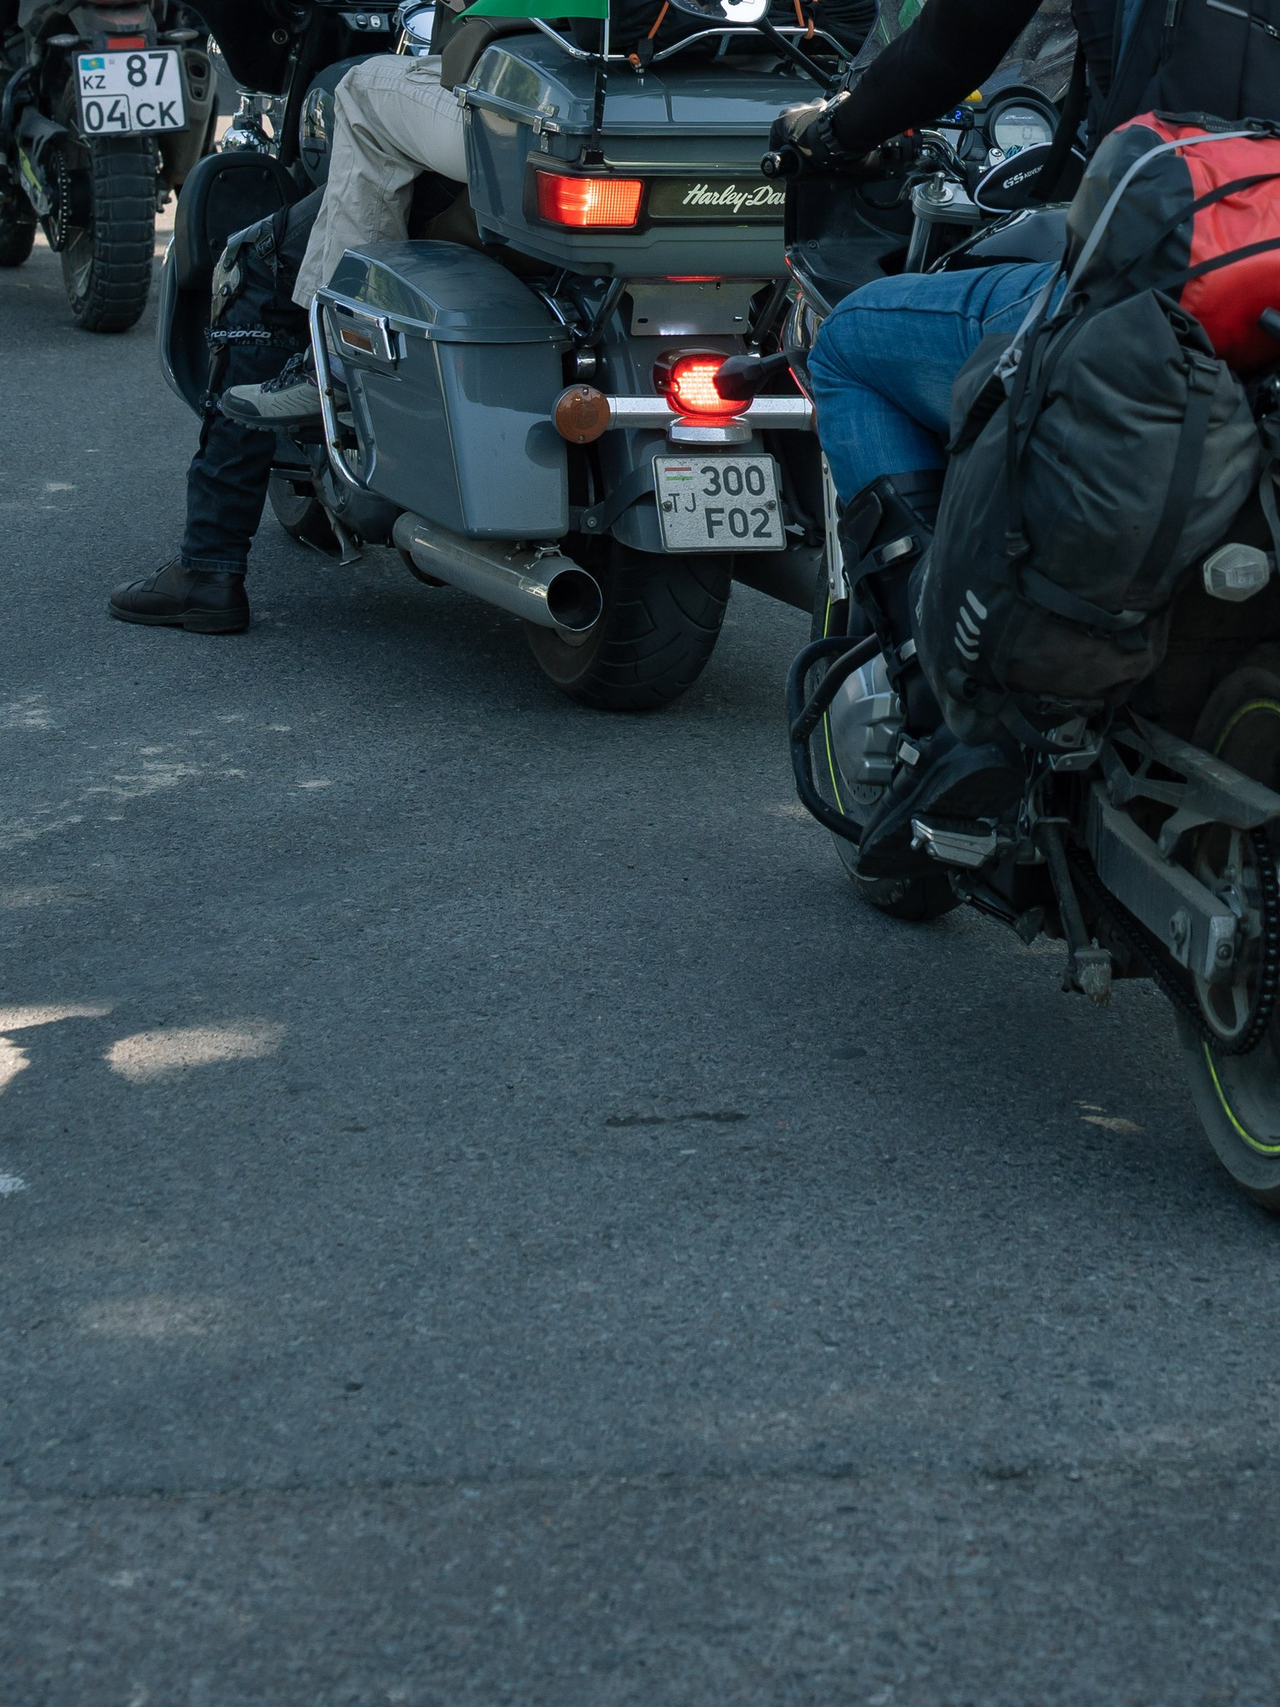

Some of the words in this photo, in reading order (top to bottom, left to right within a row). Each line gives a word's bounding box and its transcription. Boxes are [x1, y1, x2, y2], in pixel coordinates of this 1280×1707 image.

[83, 75, 106, 90] KZ
[126, 53, 169, 87] 87
[86, 100, 127, 131] 04
[136, 101, 179, 128] CK
[1024, 165, 1044, 179] ADVEN
[700, 465, 766, 497] 300
[668, 493, 697, 513] TJ
[705, 508, 772, 539] F02
